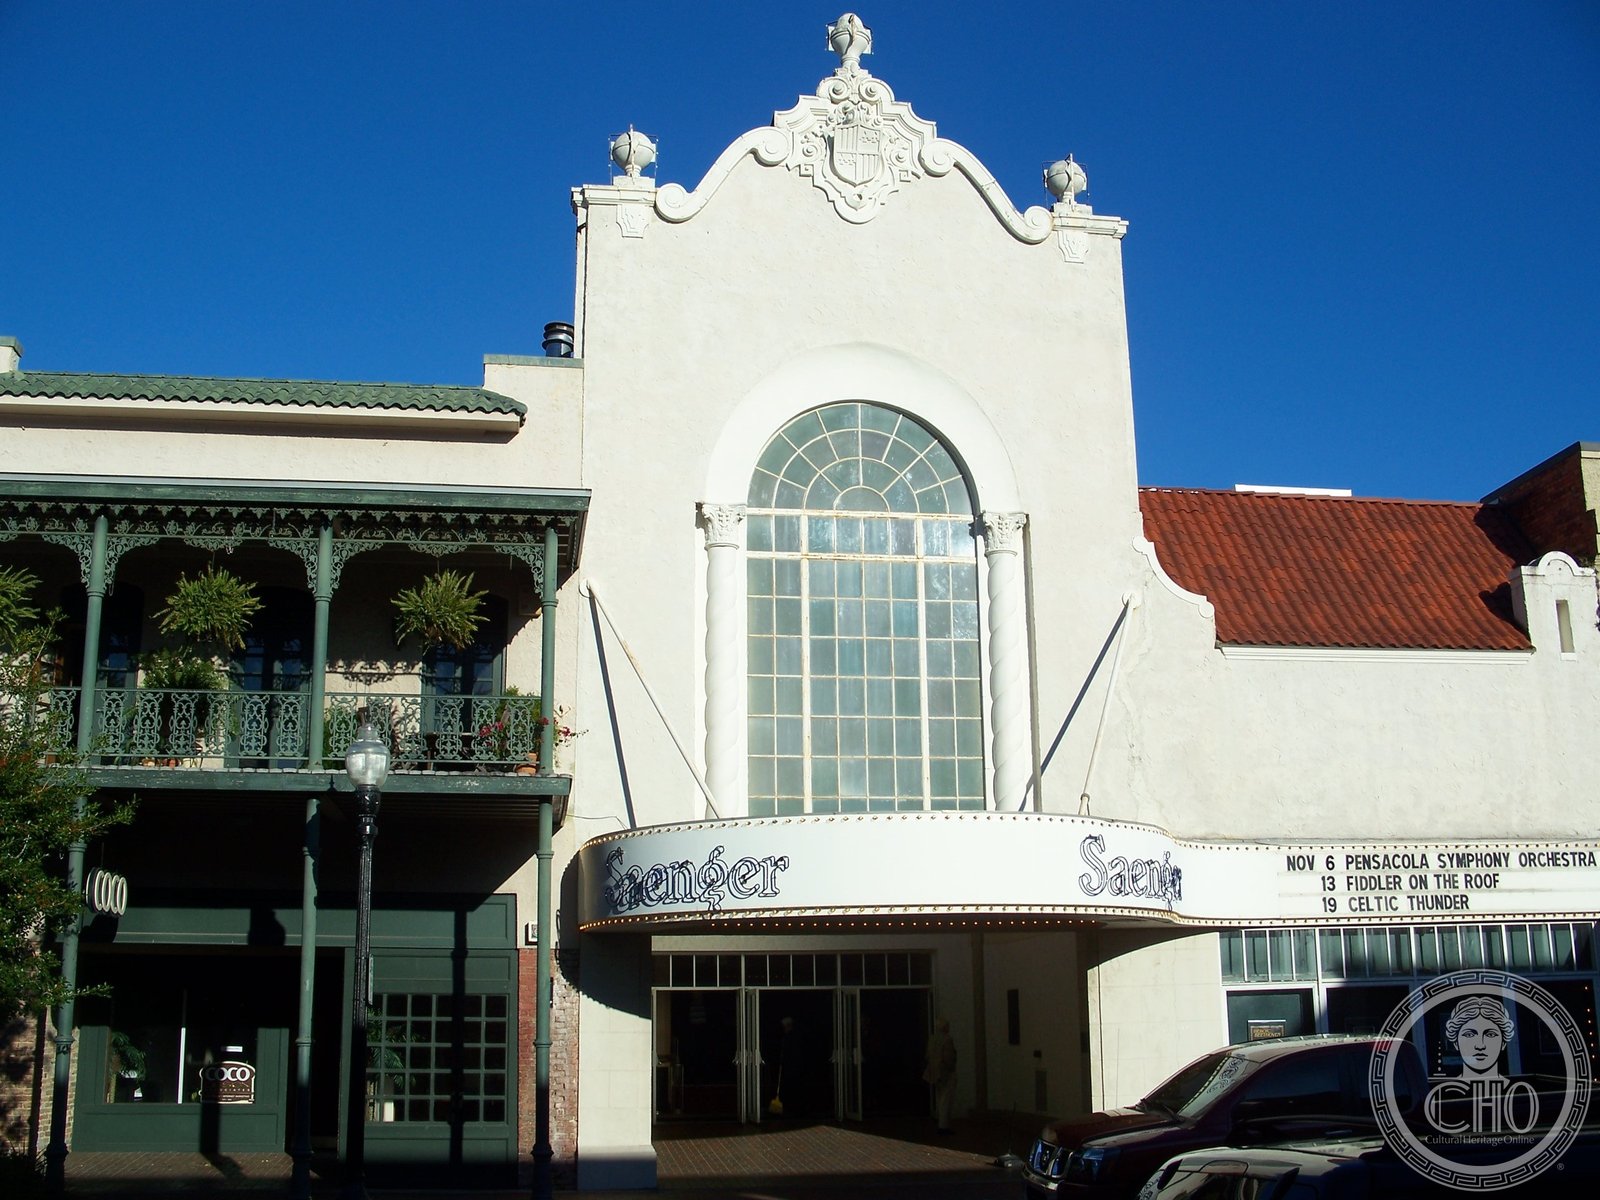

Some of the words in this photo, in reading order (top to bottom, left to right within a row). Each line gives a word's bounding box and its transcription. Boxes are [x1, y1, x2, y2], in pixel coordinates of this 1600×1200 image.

[1286, 855, 1315, 871] NOV
[1325, 855, 1335, 871] 6
[1345, 853, 1430, 870] PENSACOLA
[1437, 852, 1510, 869] SYMPHONY
[1518, 851, 1597, 868] ORCHESTRA
[605, 845, 790, 913] Saenger
[1079, 834, 1182, 911] Saenger
[1321, 875, 1336, 892] 13
[1346, 875, 1402, 891] FIDDLER
[1409, 874, 1429, 890] ON
[1433, 873, 1459, 889] THE
[1464, 873, 1500, 889] ROOF
[1322, 896, 1337, 913] 19
[1348, 895, 1399, 912] CELTIC
[1407, 894, 1470, 910] THUNDER
[205, 1066, 251, 1081] COCO
